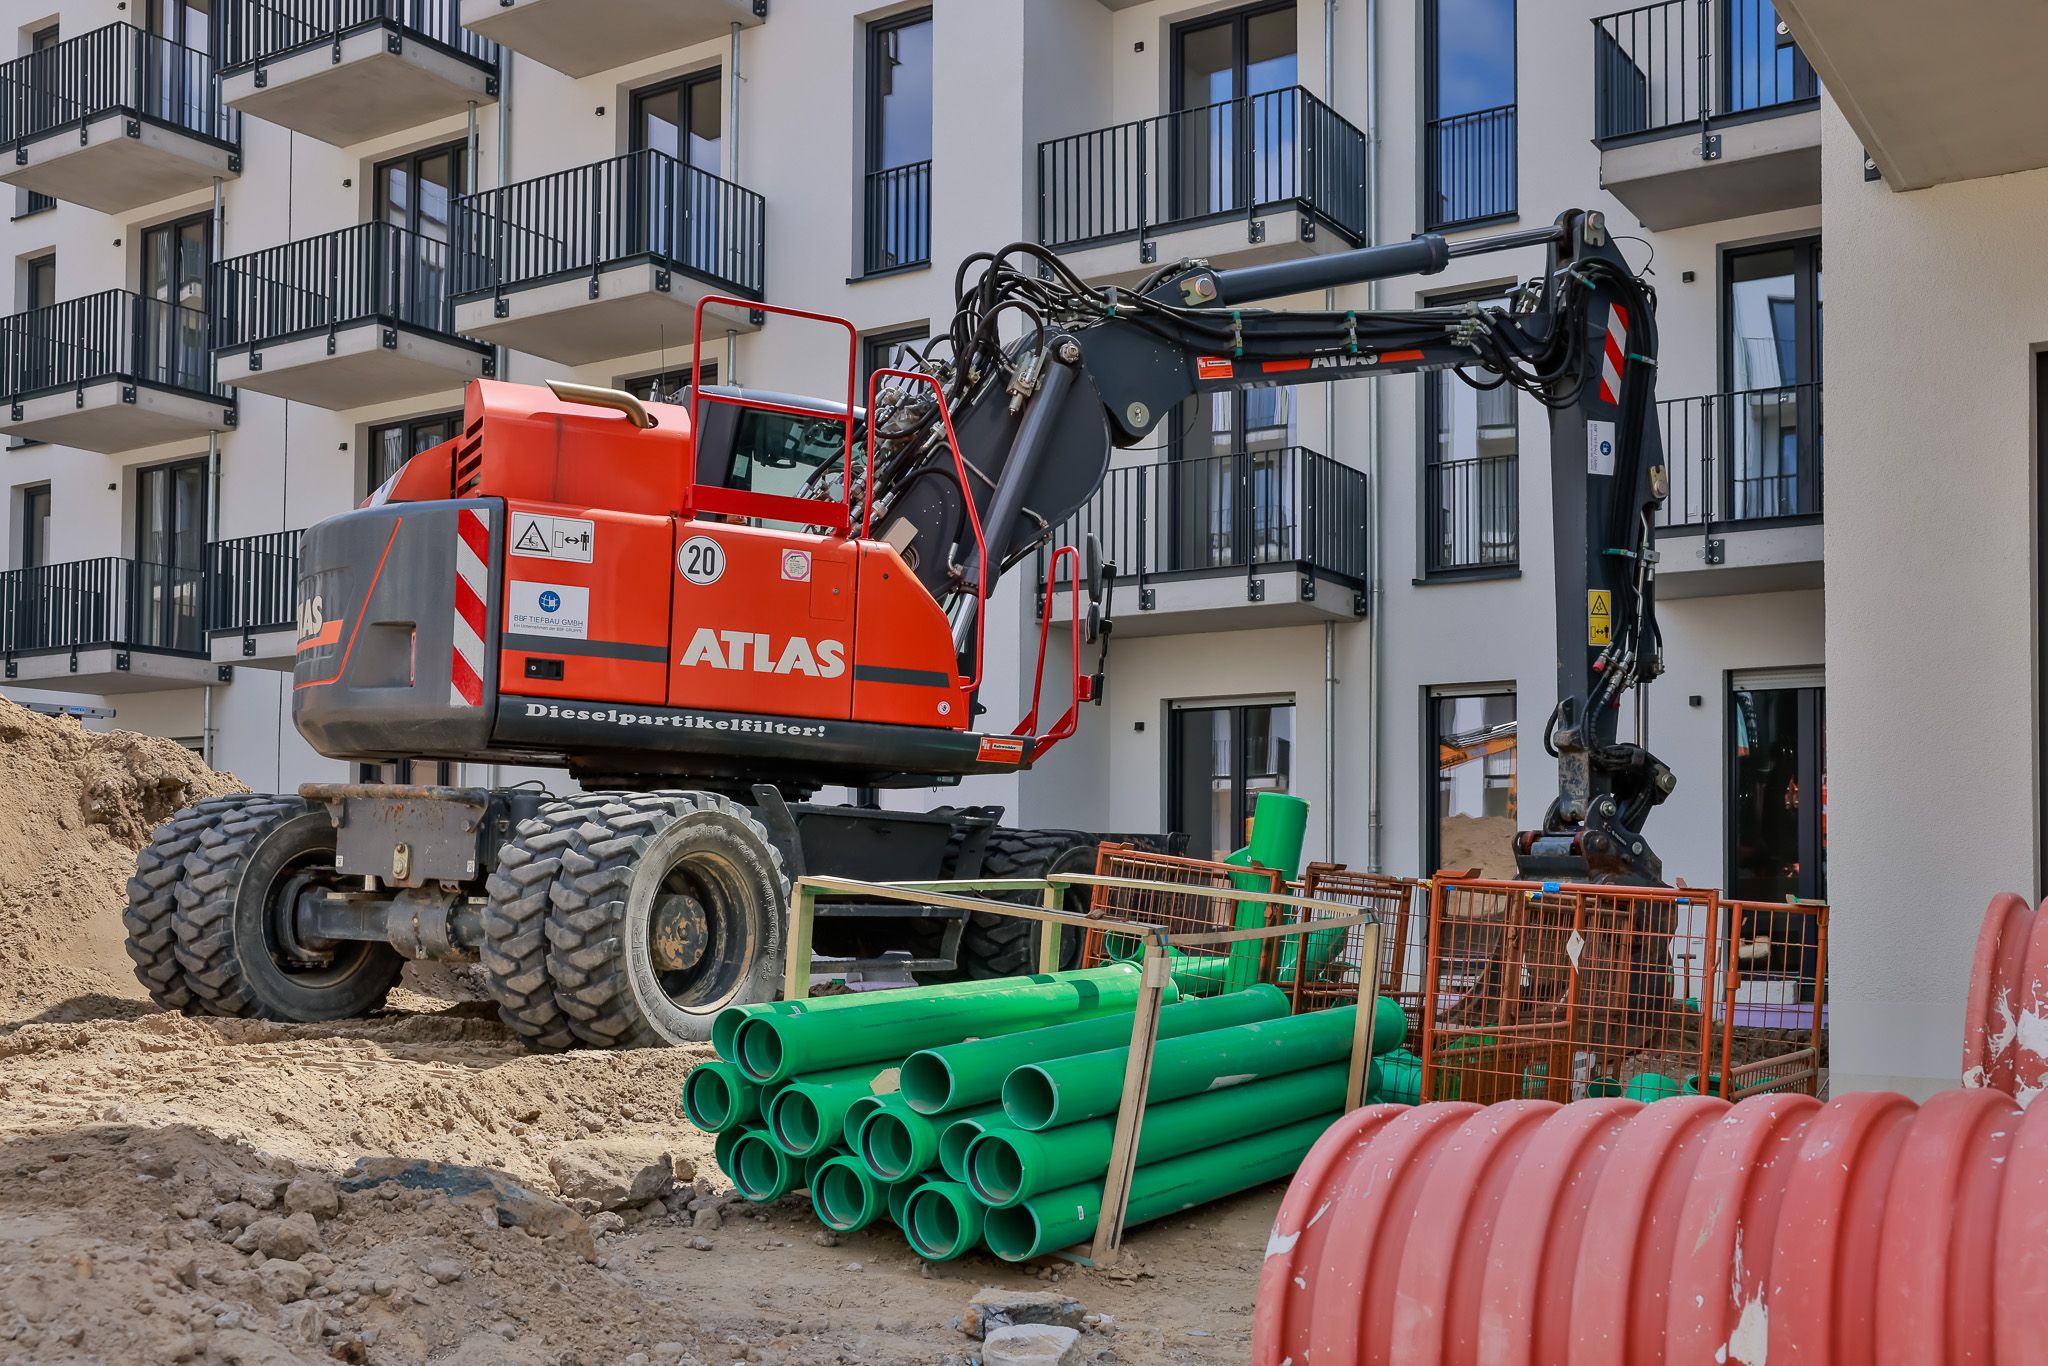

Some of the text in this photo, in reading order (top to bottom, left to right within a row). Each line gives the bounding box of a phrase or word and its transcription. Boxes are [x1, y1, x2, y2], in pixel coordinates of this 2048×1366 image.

[1311, 345, 1378, 368] ATLAS
[687, 545, 716, 576] 20
[529, 615, 560, 625] TIEFBAU
[561, 618, 584, 627] GMBH
[680, 628, 846, 678] ATLAS
[525, 703, 826, 738] Dieselpartikelfilter!
